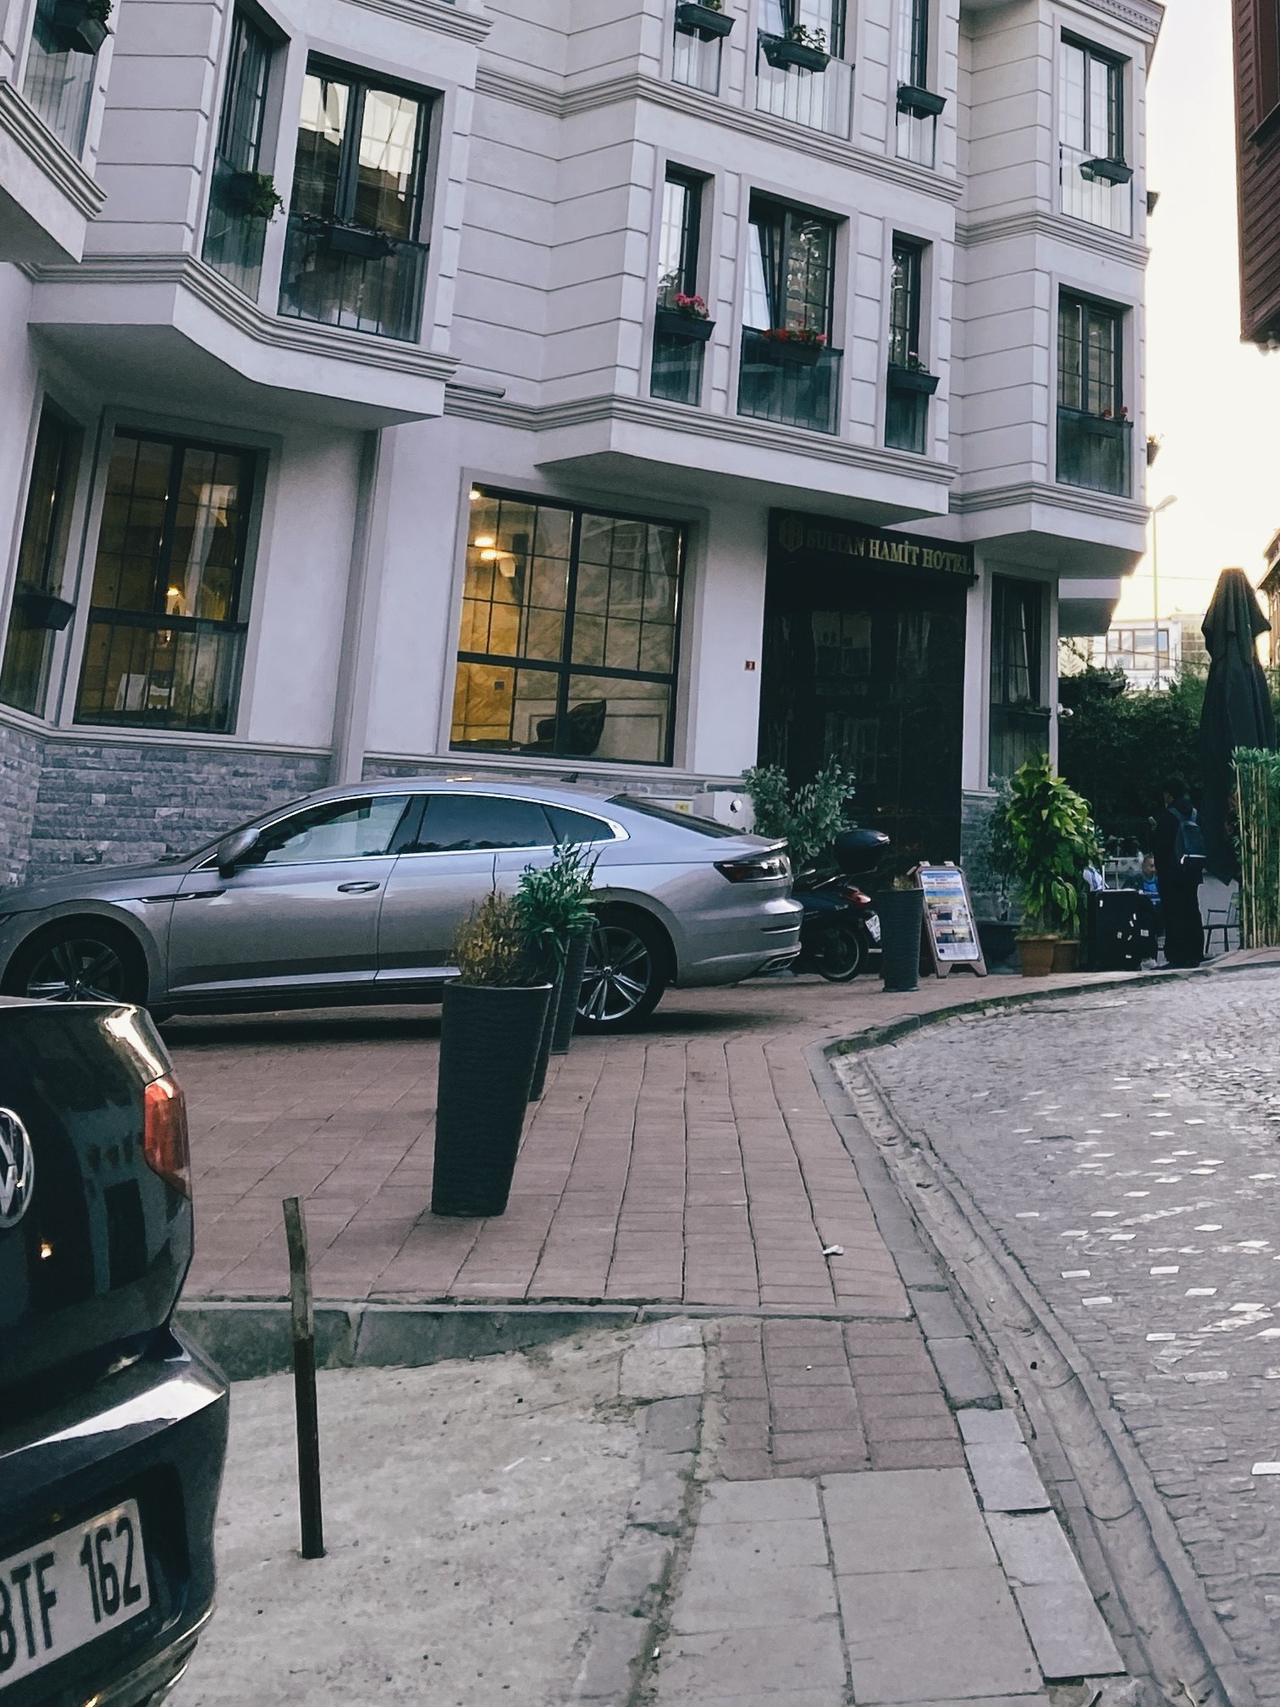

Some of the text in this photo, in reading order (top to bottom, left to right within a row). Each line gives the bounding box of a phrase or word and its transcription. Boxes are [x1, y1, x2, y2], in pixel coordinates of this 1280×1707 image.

[868, 539, 920, 565] HAMİT
[921, 547, 972, 575] HOTEL
[80, 1516, 142, 1624] 162
